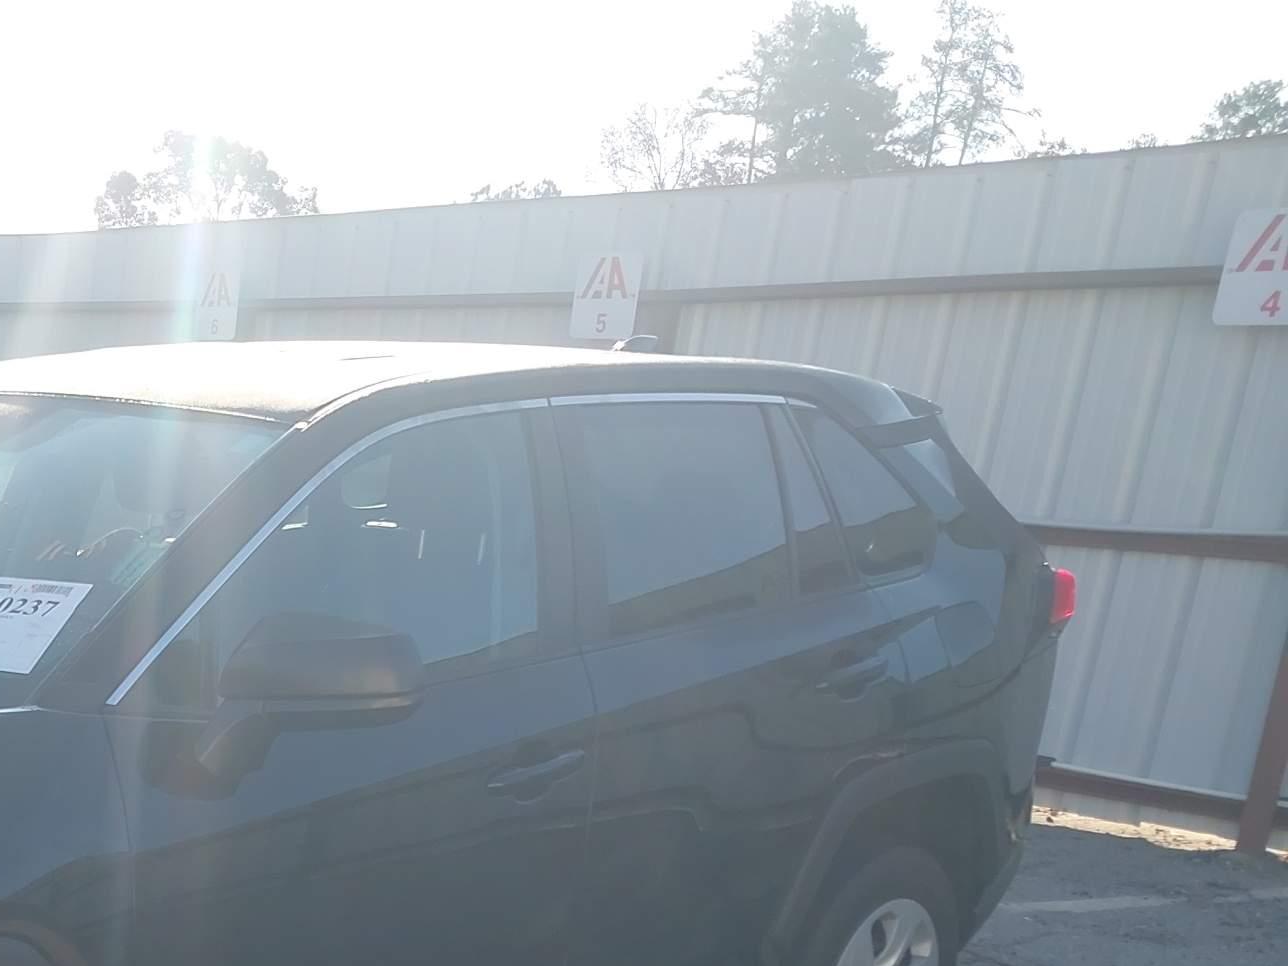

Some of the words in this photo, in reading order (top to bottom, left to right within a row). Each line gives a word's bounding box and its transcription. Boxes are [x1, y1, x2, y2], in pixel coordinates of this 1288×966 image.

[1260, 289, 1282, 318] 4
[209, 318, 219, 336] 6
[595, 312, 608, 334] 5
